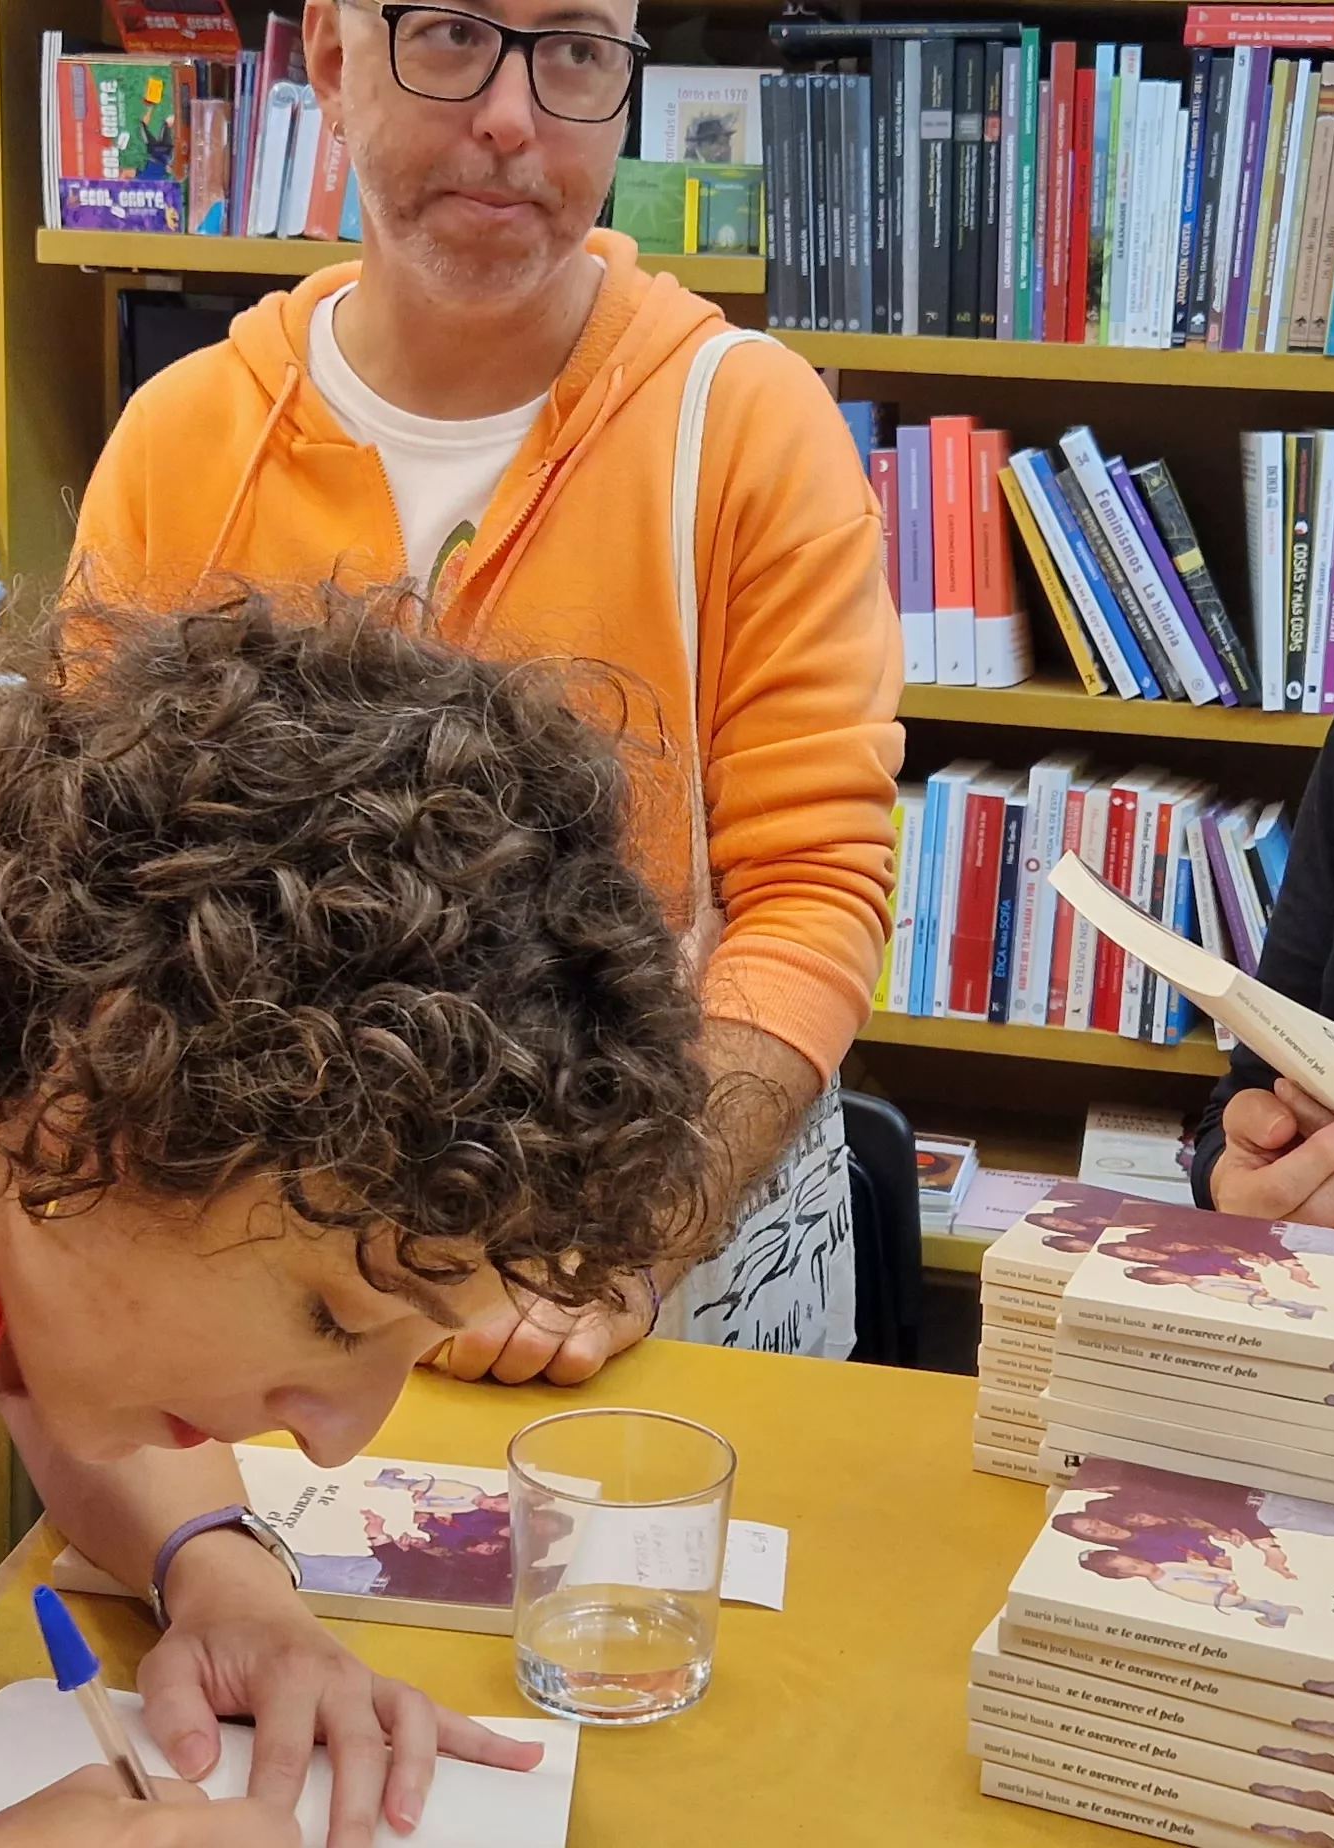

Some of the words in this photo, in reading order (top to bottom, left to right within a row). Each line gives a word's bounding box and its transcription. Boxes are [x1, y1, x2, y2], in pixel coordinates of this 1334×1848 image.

[678, 88, 704, 100] toros
[708, 90, 720, 100] en
[1181, 223, 1192, 256] COSTA
[1095, 489, 1144, 574] Feminismos
[1142, 583, 1156, 600] La
[1152, 599, 1180, 648] historia
[1293, 543, 1308, 582] COSAS
[1289, 617, 1304, 652] COSAS
[1144, 811, 1152, 841] Rafael
[1079, 922, 1088, 941] SIN
[1074, 942, 1086, 996] PUNTERAS
[1079, 1312, 1103, 1320] maría
[1105, 1315, 1121, 1323] josé
[1178, 1328, 1224, 1340] oscurece
[1227, 1334, 1237, 1343] el
[1236, 1334, 1262, 1347] pelo
[282, 1486, 318, 1529] oscurece
[1025, 1610, 1051, 1621] maría
[1054, 1614, 1072, 1625] josé
[1106, 1627, 1118, 1635] se
[1135, 1633, 1186, 1650] oscurece
[1188, 1643, 1200, 1653] el
[1201, 1646, 1227, 1659] pelo
[1022, 1638, 1047, 1650] maría
[1050, 1644, 1067, 1655] josé
[1100, 1658, 1112, 1666] se
[1128, 1665, 1181, 1685] oscurece
[1180, 1678, 1194, 1690] el
[1193, 1681, 1218, 1694] pelo
[989, 1670, 1014, 1681] maría
[1017, 1675, 1034, 1686] josé
[1067, 1689, 1079, 1697] se
[1094, 1696, 1147, 1713] oscurece
[1146, 1707, 1158, 1717] el
[1159, 1710, 1184, 1723] pelo
